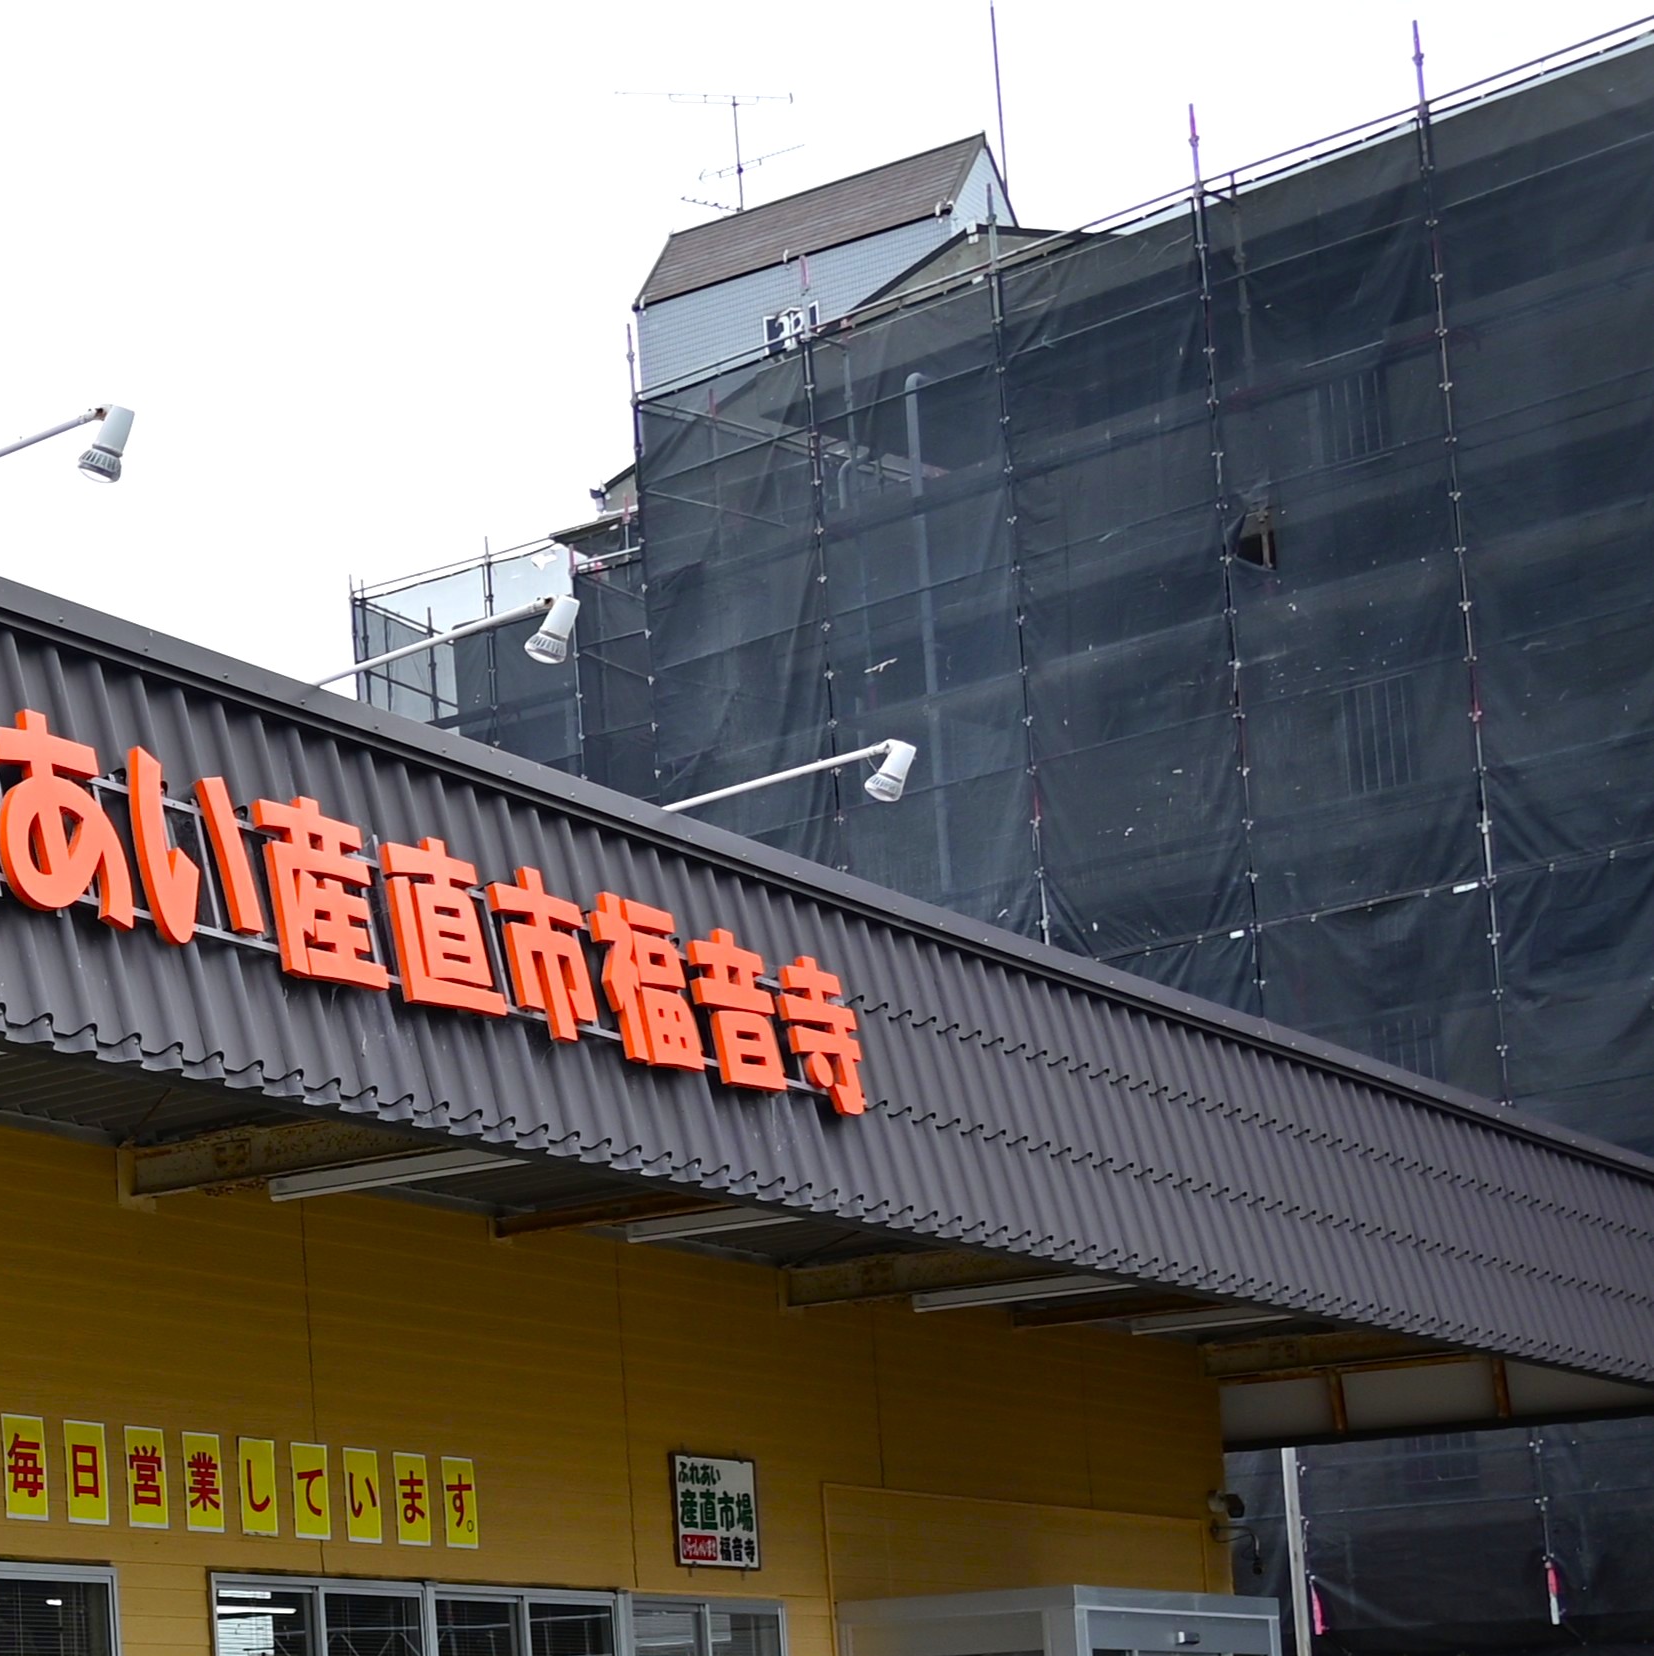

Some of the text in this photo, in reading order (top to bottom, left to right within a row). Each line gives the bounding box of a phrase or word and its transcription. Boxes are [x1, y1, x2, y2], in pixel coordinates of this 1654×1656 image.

[678, 1461, 721, 1486] ふれあい
[680, 1489, 754, 1532] 産直市場
